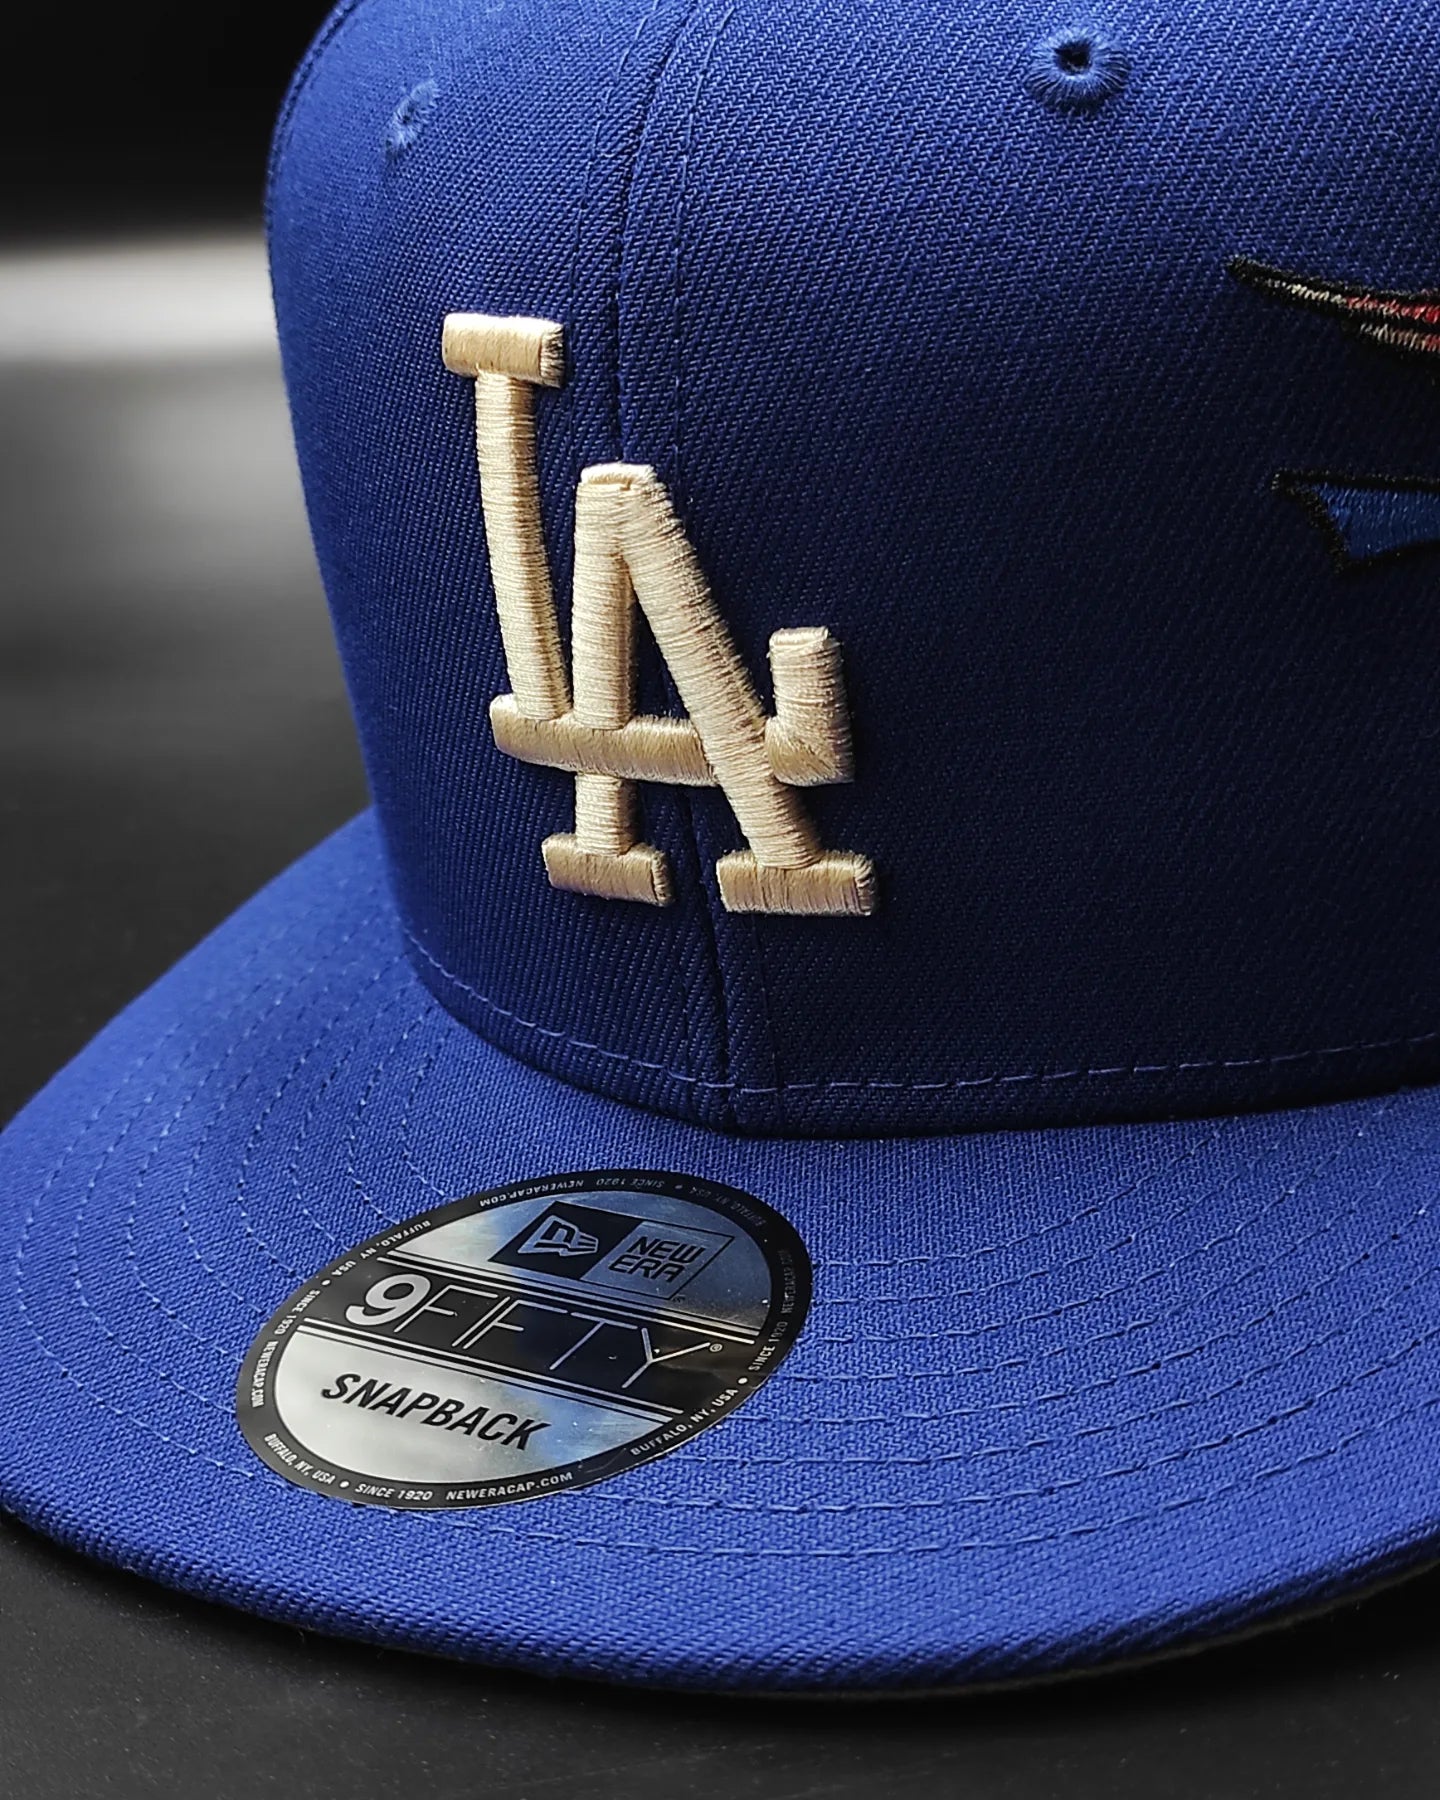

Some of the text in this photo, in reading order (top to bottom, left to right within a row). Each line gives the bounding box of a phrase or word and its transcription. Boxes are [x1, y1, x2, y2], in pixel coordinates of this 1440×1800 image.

[442, 312, 877, 918] LA
[479, 1178, 666, 1208] SINCE 1920 NEWERACAP.COM
[626, 1235, 706, 1264] NEW
[331, 1260, 357, 1276] USA
[607, 1253, 687, 1283] ERA
[292, 1289, 321, 1312] SINCE
[274, 1315, 297, 1335] 1920
[748, 1345, 776, 1371] SINCE
[768, 1321, 788, 1342] 1920
[321, 1373, 550, 1451] SNAPBACK
[630, 1424, 693, 1456] BUFFALO,
[711, 1388, 738, 1407] USA
[264, 1433, 298, 1466] BUFFALO,
[312, 1470, 336, 1485] USA
[355, 1471, 573, 1501] SINCE 1920 NEWERACAP.COM
